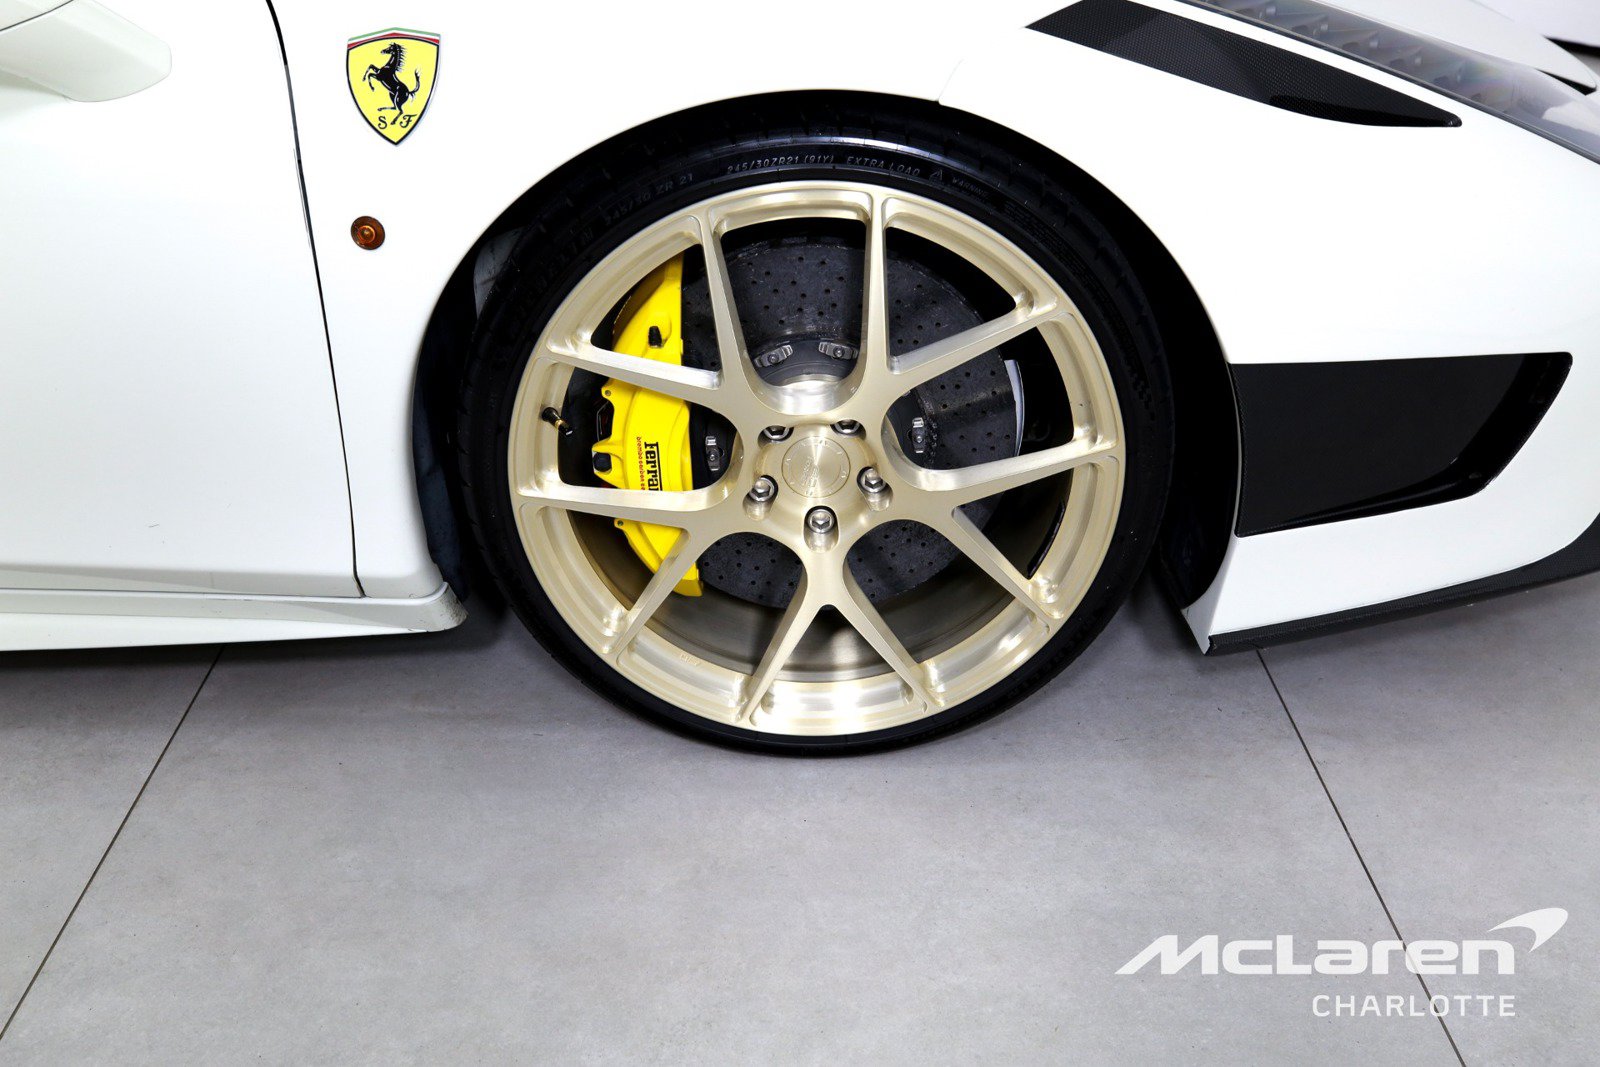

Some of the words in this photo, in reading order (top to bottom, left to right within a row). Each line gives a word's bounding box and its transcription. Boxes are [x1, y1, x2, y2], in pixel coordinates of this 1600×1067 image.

[377, 115, 388, 130] S
[399, 113, 418, 129] F
[846, 155, 885, 169] EXTRA
[888, 162, 922, 177] LOAD
[644, 441, 663, 491] Ferra
